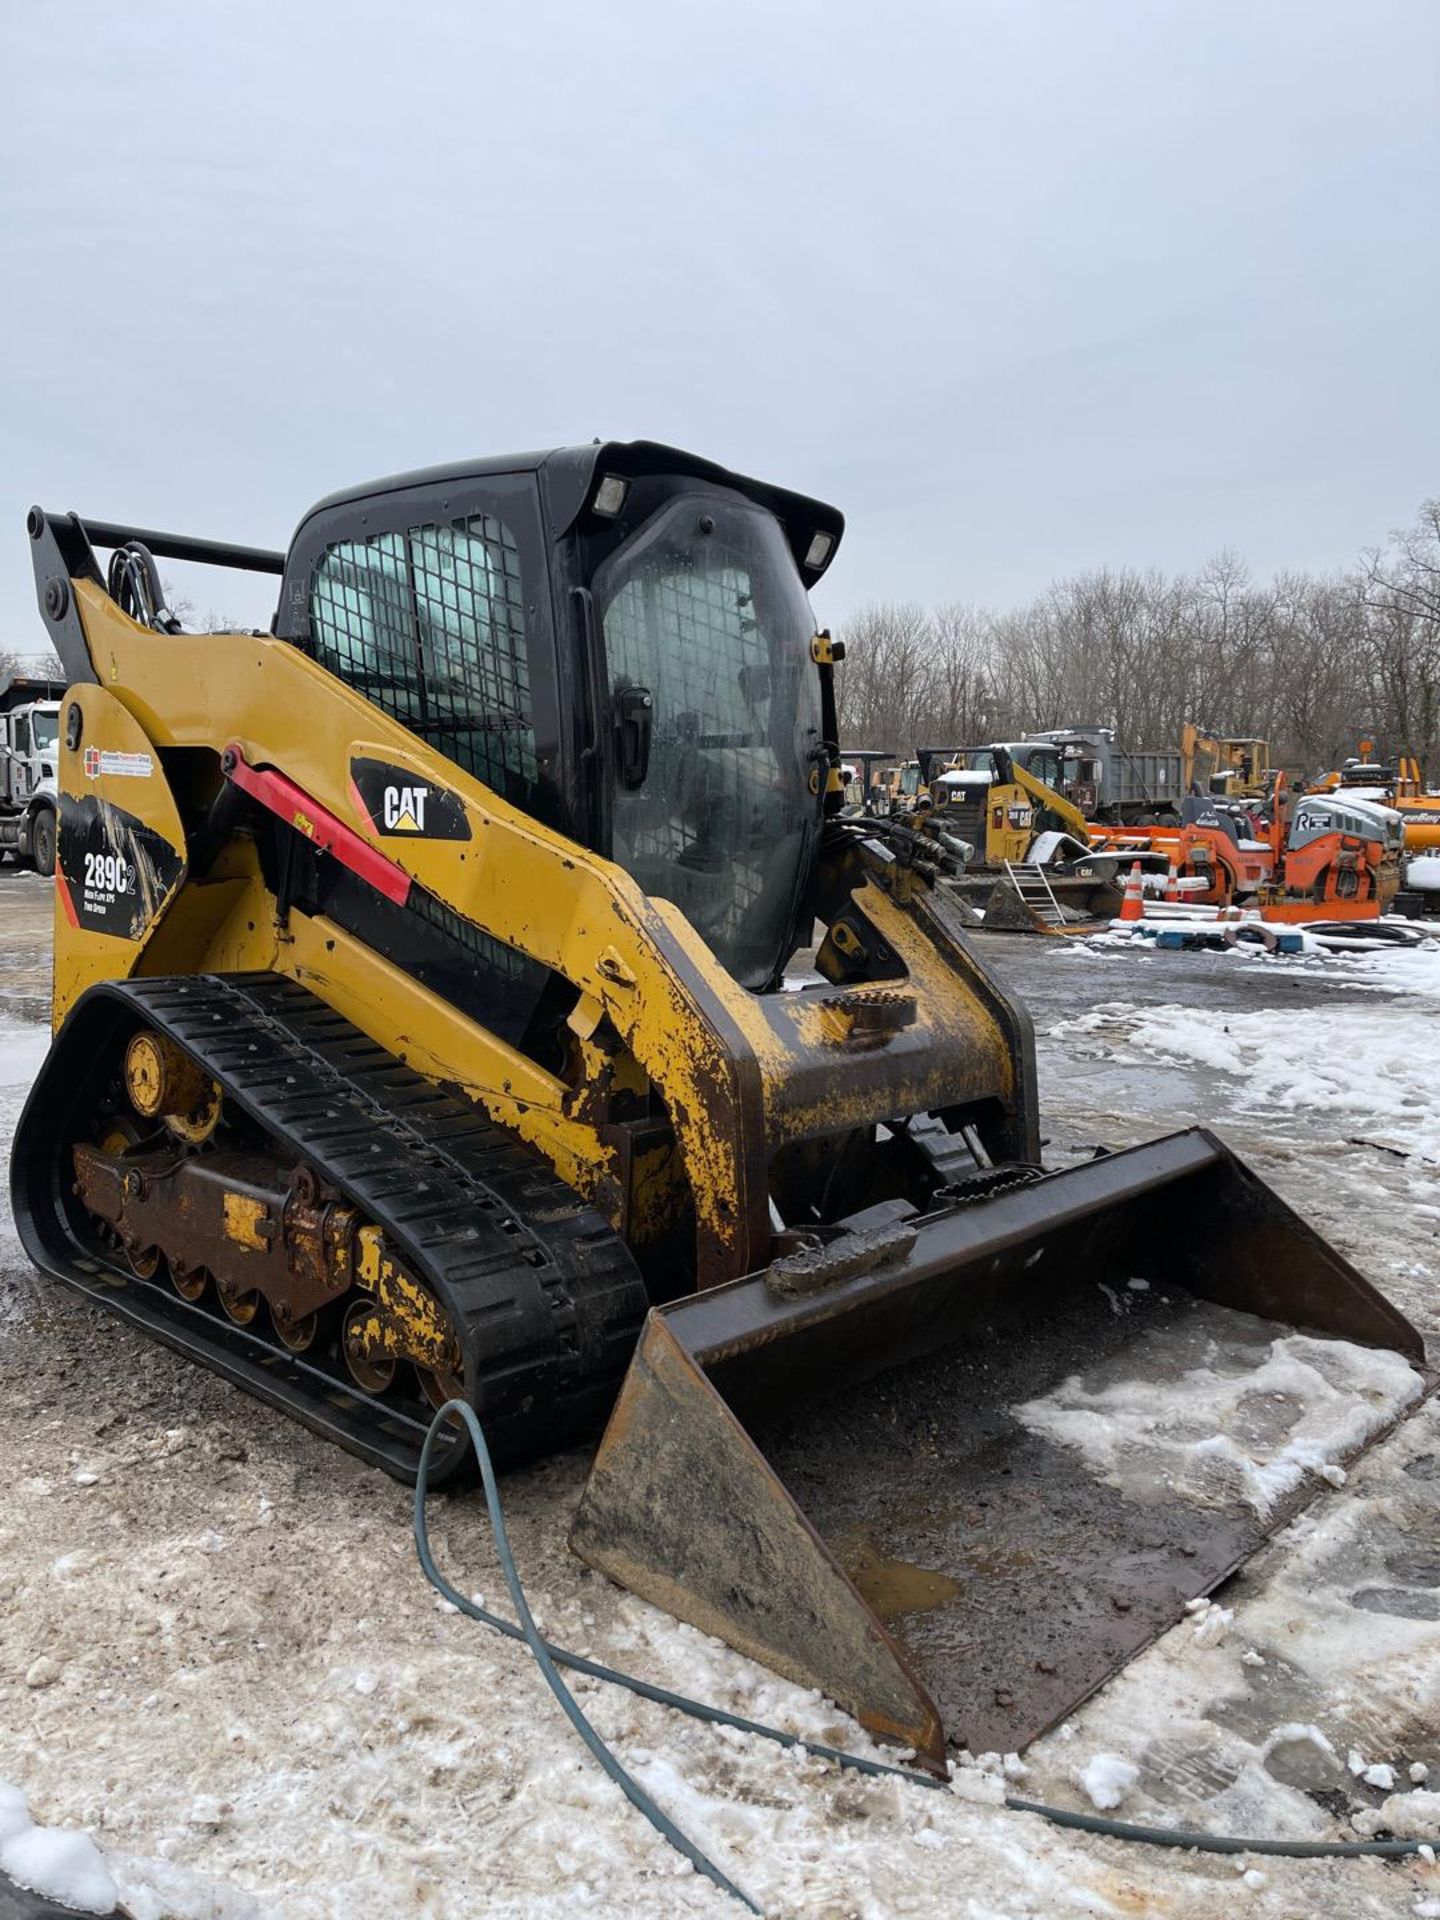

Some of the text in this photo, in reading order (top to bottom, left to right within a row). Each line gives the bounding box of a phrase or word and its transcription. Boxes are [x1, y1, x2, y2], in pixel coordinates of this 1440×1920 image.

[951, 790, 966, 802] CAT
[384, 786, 428, 830] CAT
[1019, 811, 1032, 827] CAT
